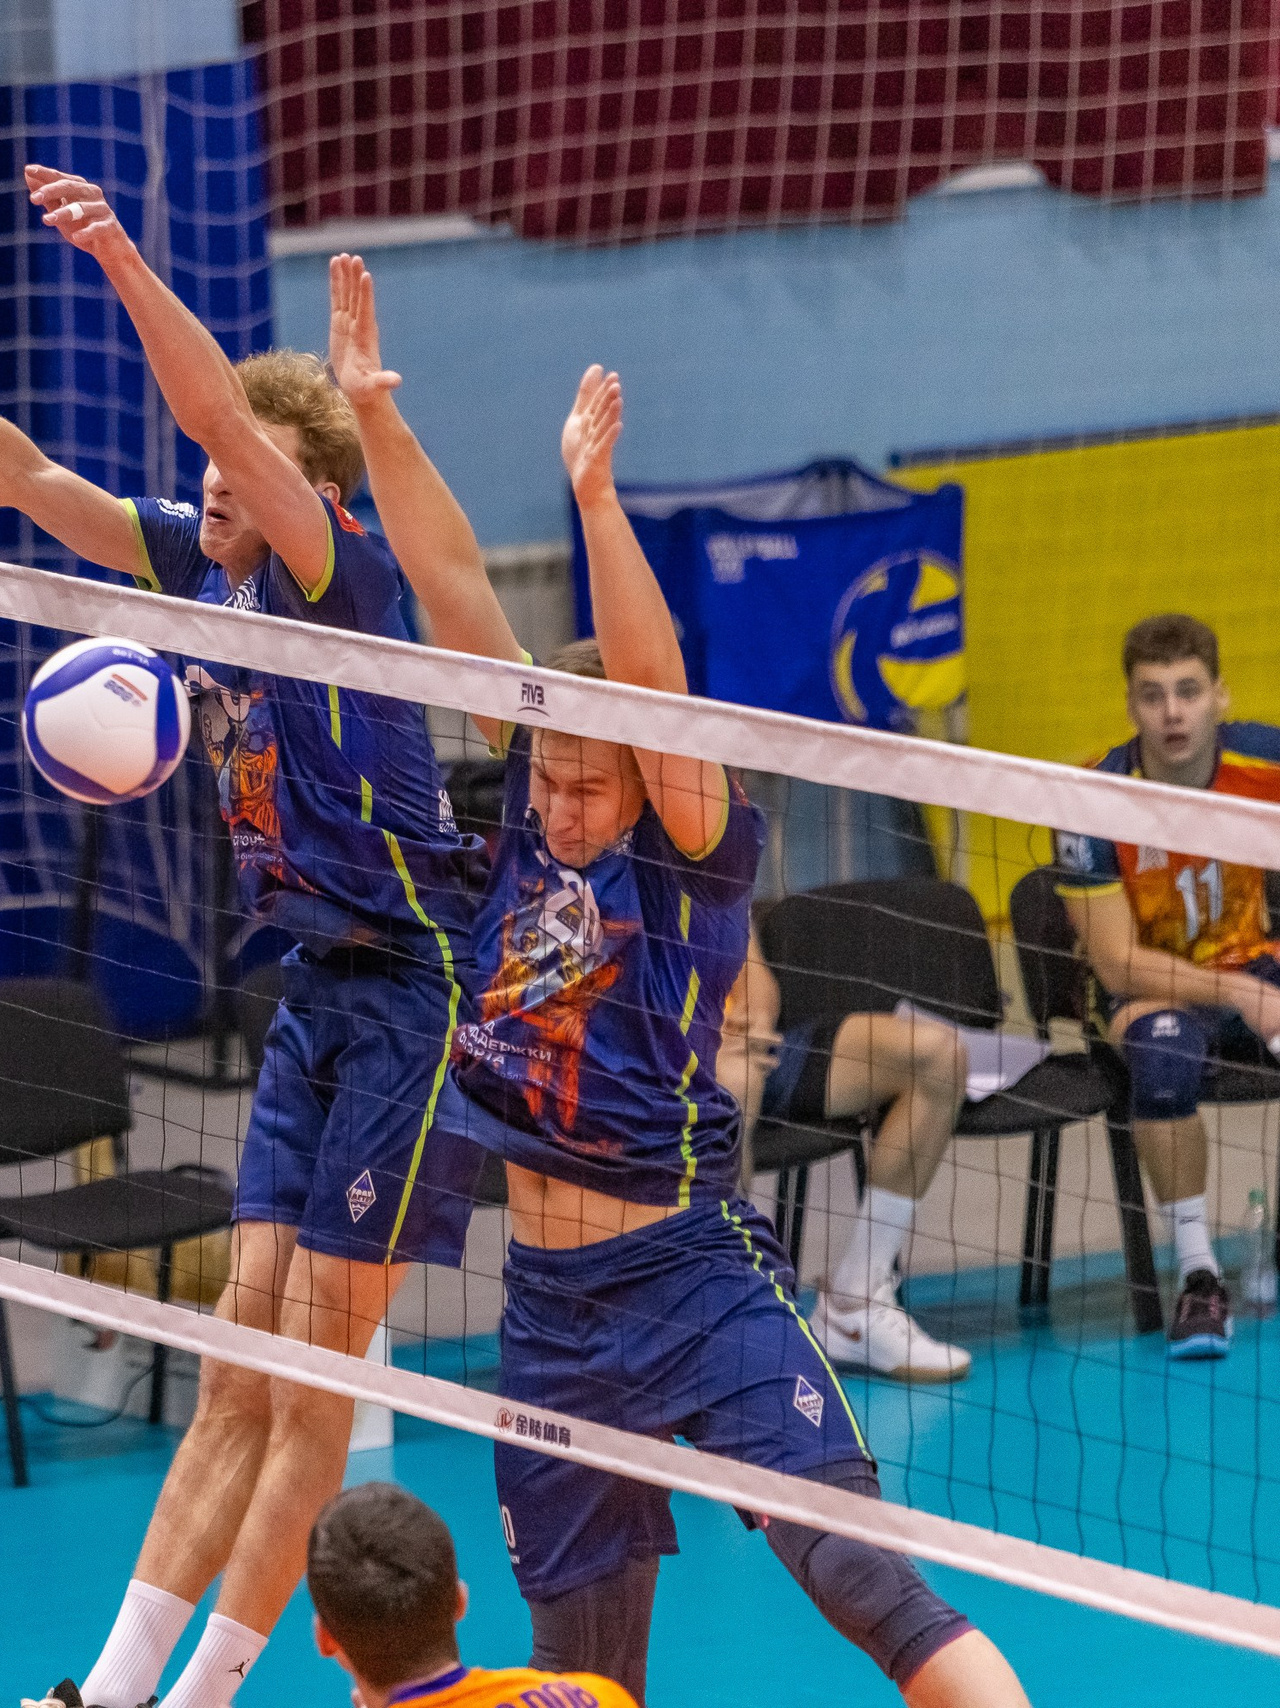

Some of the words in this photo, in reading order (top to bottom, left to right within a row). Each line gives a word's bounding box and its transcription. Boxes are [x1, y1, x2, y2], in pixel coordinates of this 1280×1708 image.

[522, 682, 545, 706] FIVB
[1176, 858, 1223, 943] 11
[515, 1413, 572, 1449] 金陵体育
